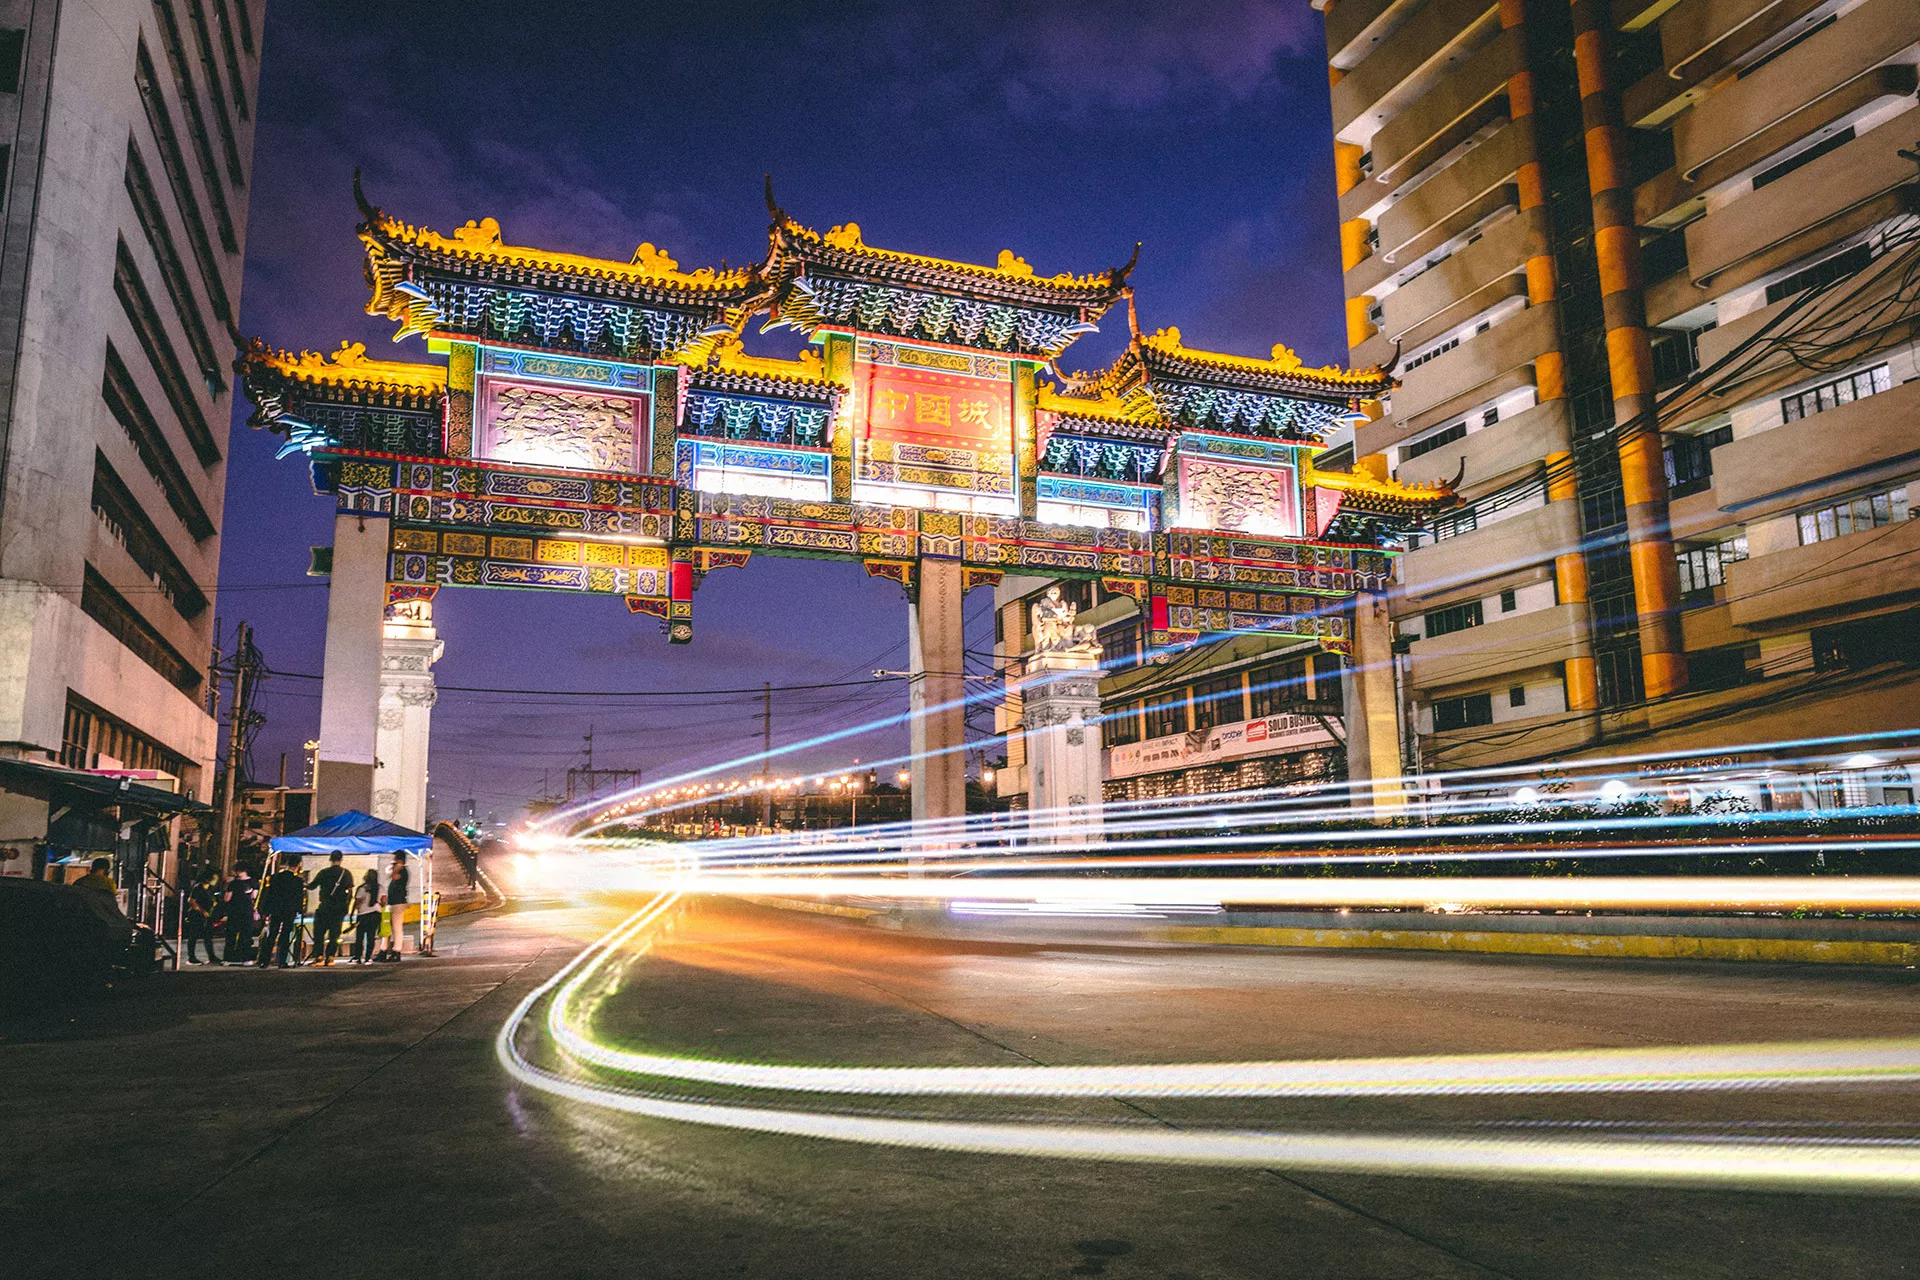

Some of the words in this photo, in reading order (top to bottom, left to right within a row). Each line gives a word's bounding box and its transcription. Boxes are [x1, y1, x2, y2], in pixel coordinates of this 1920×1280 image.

[874, 388, 993, 430] 中國城
[1268, 716, 1288, 732] SOLID
[1289, 714, 1321, 728] BUSINES
[1222, 730, 1243, 740] brother
